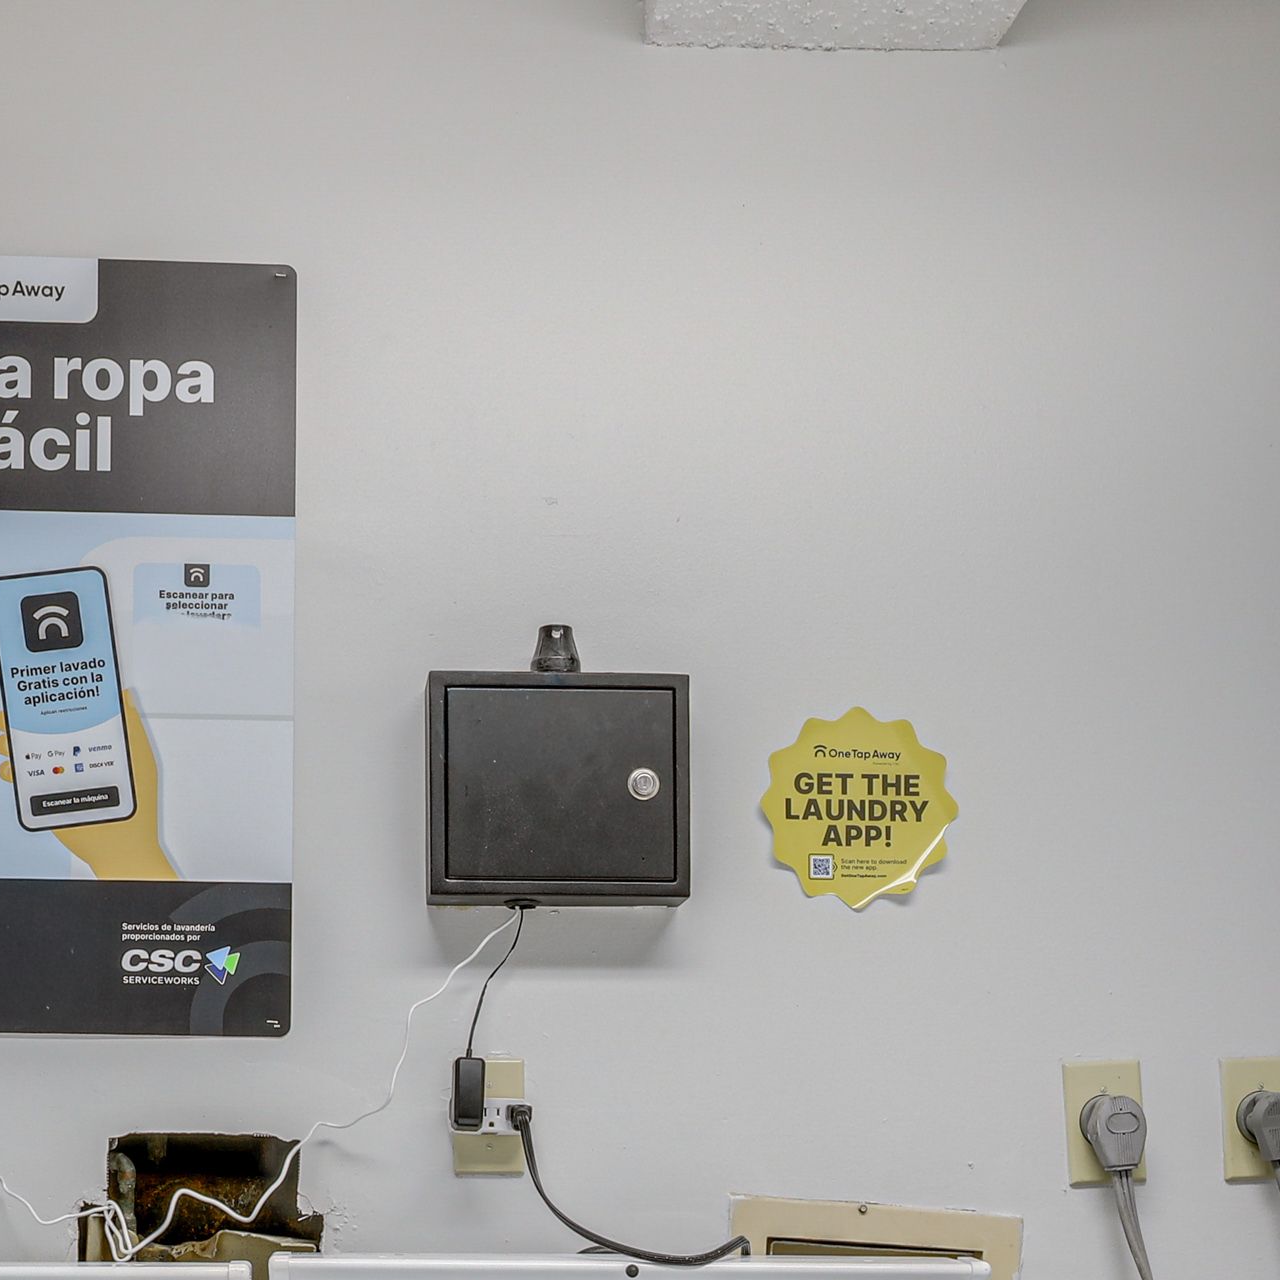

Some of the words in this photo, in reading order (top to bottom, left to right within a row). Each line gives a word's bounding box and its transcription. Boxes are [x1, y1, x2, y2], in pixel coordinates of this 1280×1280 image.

[52, 356, 215, 417] ropa
[10, 665, 57, 679] Primer
[59, 657, 106, 673] lavado
[17, 677, 60, 692] Gratis
[62, 674, 89, 688] con
[90, 671, 104, 683] la
[24, 685, 100, 707] aplicación!
[794, 772, 854, 796] GET
[861, 773, 920, 797] THE
[784, 797, 929, 823] LAUNDRY
[821, 824, 892, 848] APP!
[121, 922, 160, 931] Servicios
[161, 923, 172, 931] de
[121, 932, 185, 942] proporcionados
[186, 934, 201, 942] por
[121, 948, 203, 973] CSC
[122, 975, 200, 986] SERVICEWORKS
